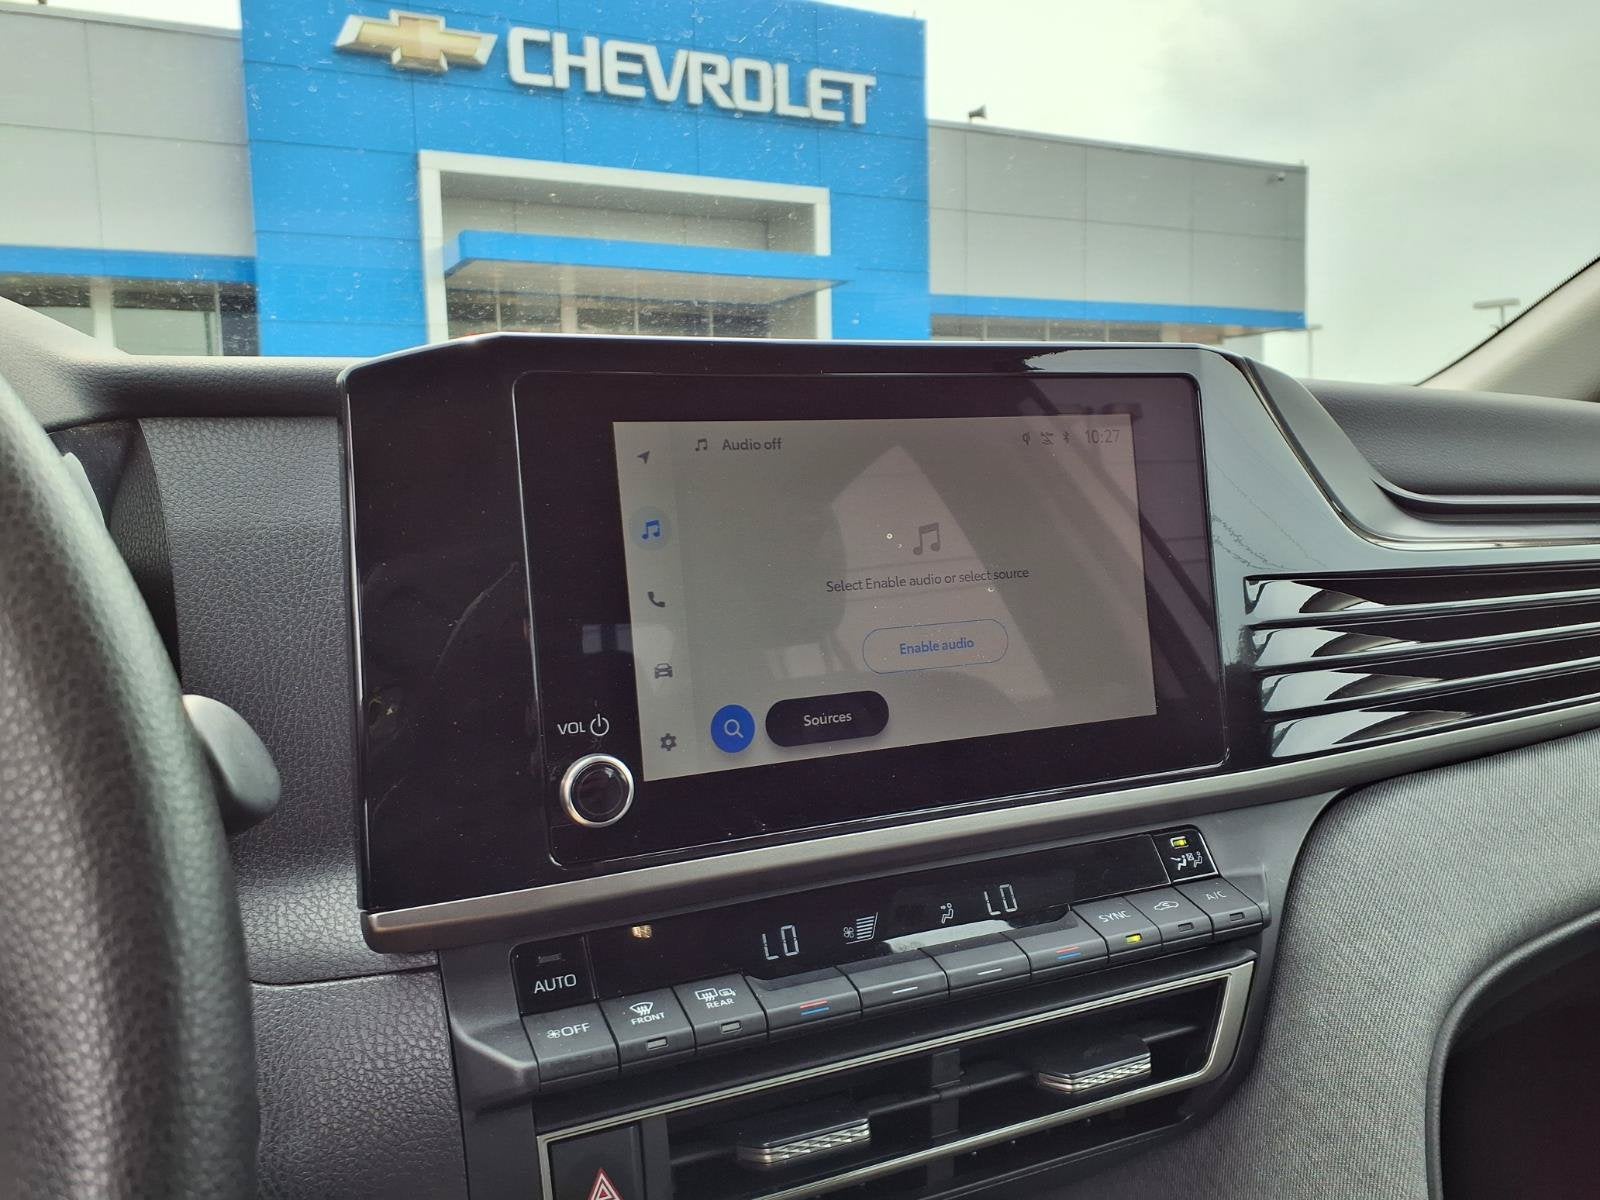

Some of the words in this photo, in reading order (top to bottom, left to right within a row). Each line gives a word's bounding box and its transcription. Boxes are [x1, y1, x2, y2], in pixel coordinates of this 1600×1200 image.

[507, 26, 877, 126] CHEVROLET
[722, 438, 762, 451] Audio
[764, 437, 783, 451] off
[1085, 429, 1120, 444] 10:27
[826, 578, 863, 593] Select
[865, 576, 906, 591] Enable
[909, 573, 942, 587] audio
[944, 573, 957, 584] or
[959, 570, 993, 583] select
[993, 568, 1030, 580] source
[899, 641, 939, 655] Enable
[941, 637, 975, 651] audio
[803, 711, 853, 728] Sources
[557, 721, 587, 736] VOL
[1205, 889, 1228, 901] A/C
[1098, 910, 1132, 924] SYNC
[533, 973, 577, 994] AUTO
[706, 998, 735, 1010] REAR
[630, 1011, 666, 1026] FRONT
[561, 1022, 591, 1037] OFF
